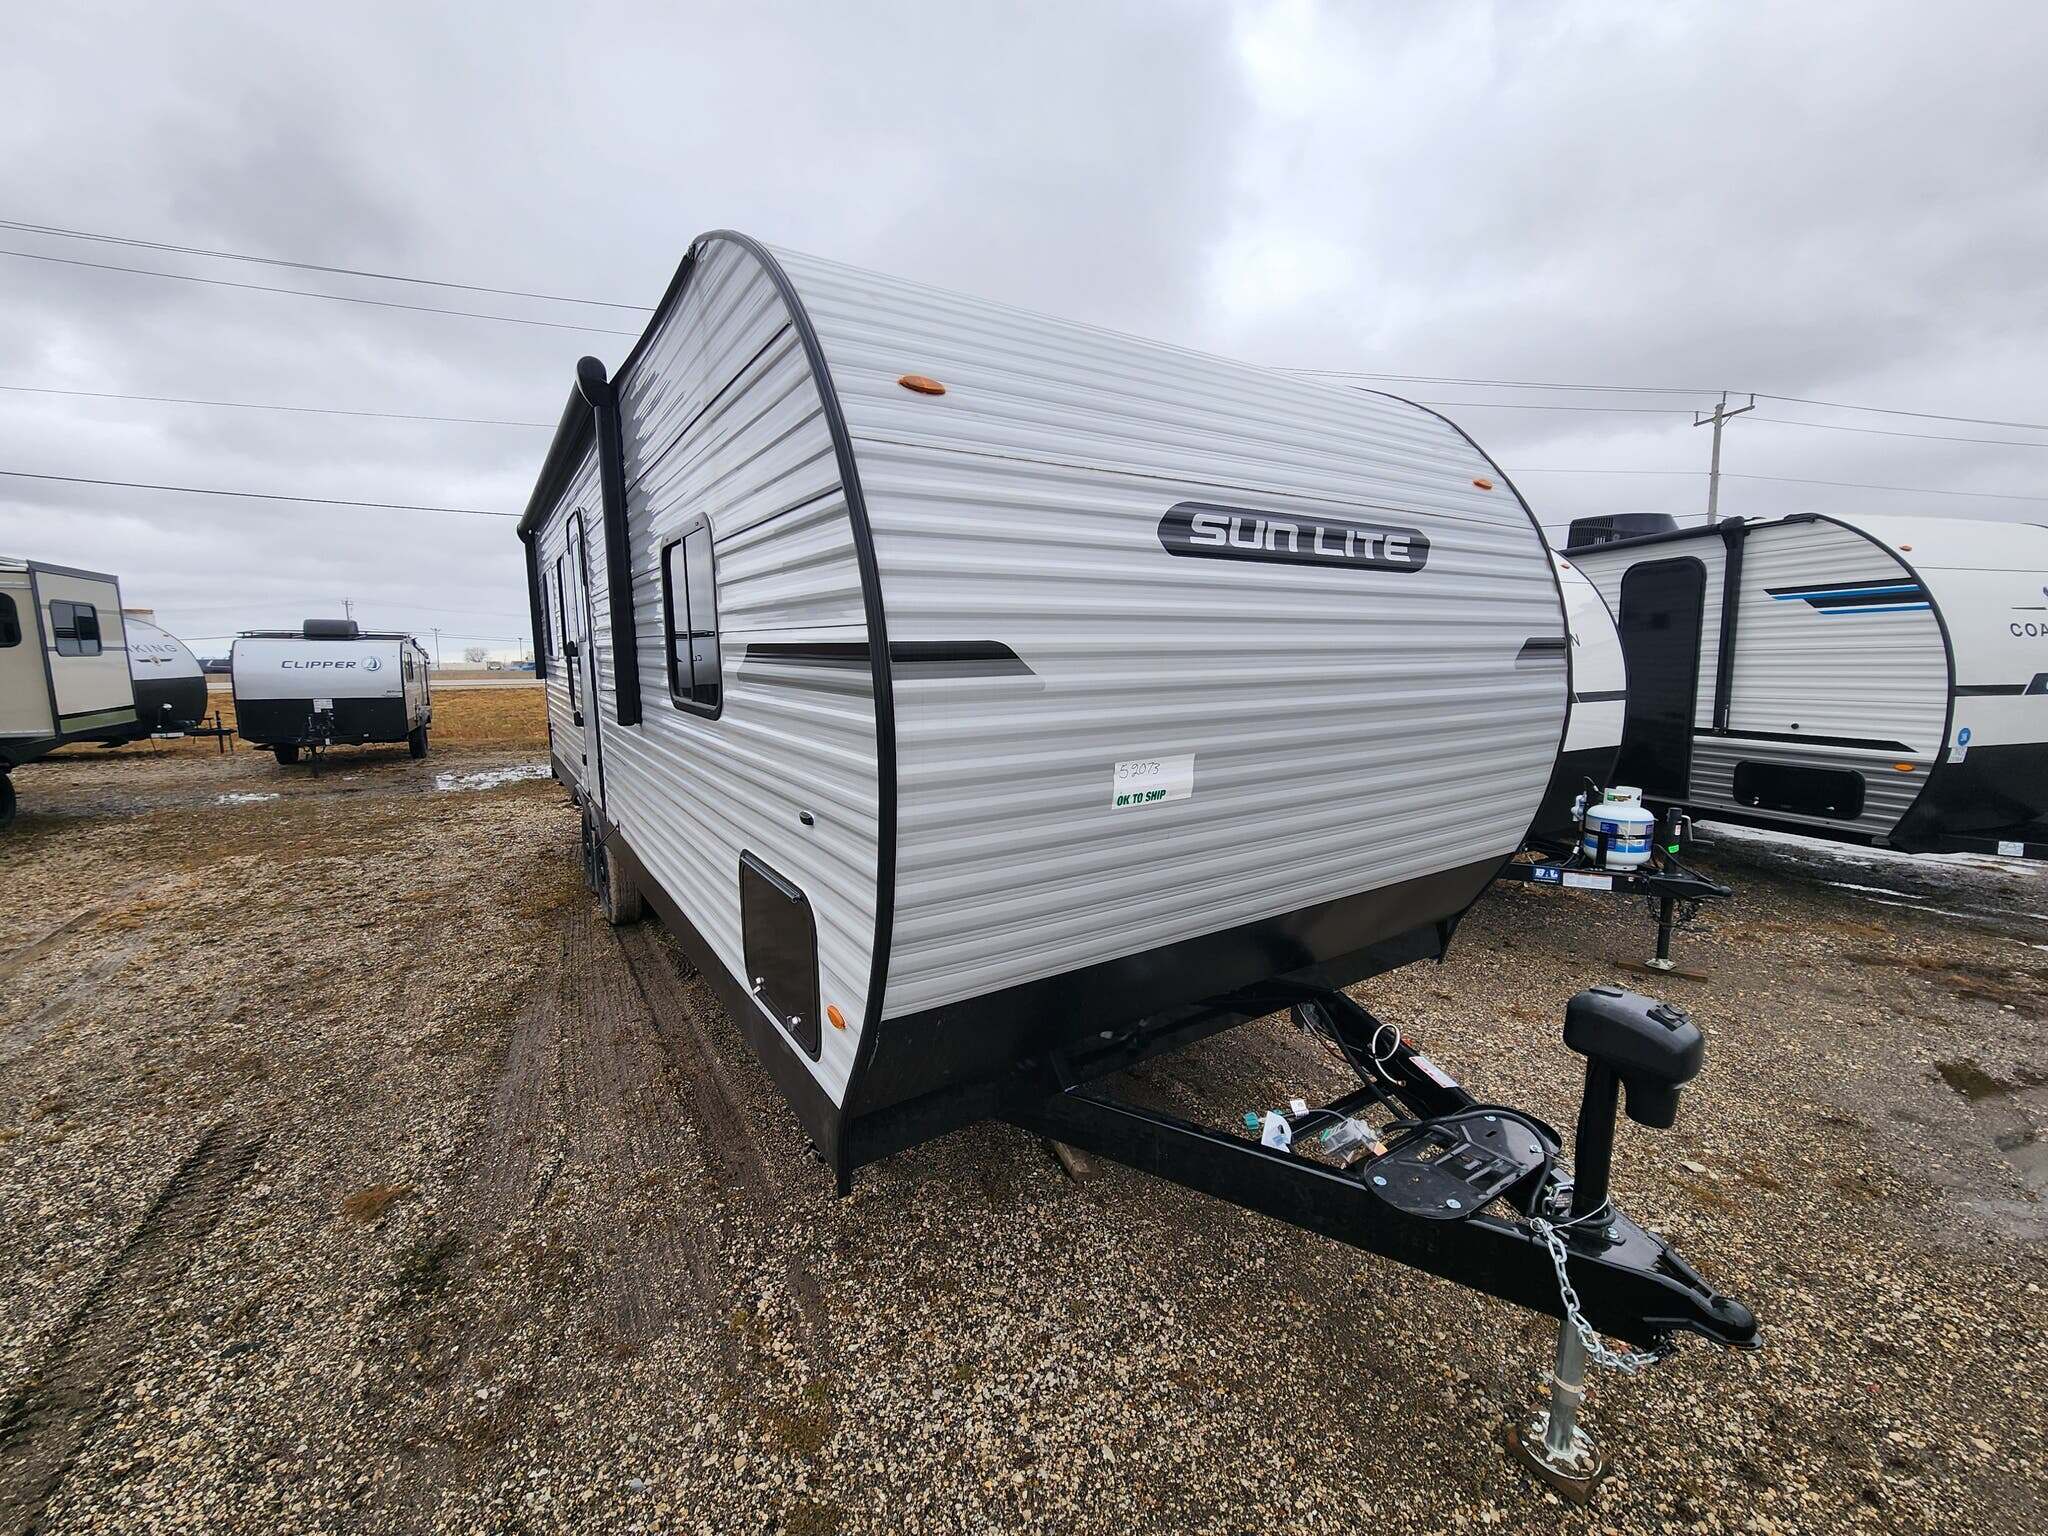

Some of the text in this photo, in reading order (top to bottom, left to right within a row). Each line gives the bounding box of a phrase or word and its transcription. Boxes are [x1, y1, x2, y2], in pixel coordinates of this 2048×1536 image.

[1190, 513, 1411, 562] SUN LITE
[281, 660, 356, 669] CLIPPER
[1117, 789, 1167, 806] OK TO SHIP
